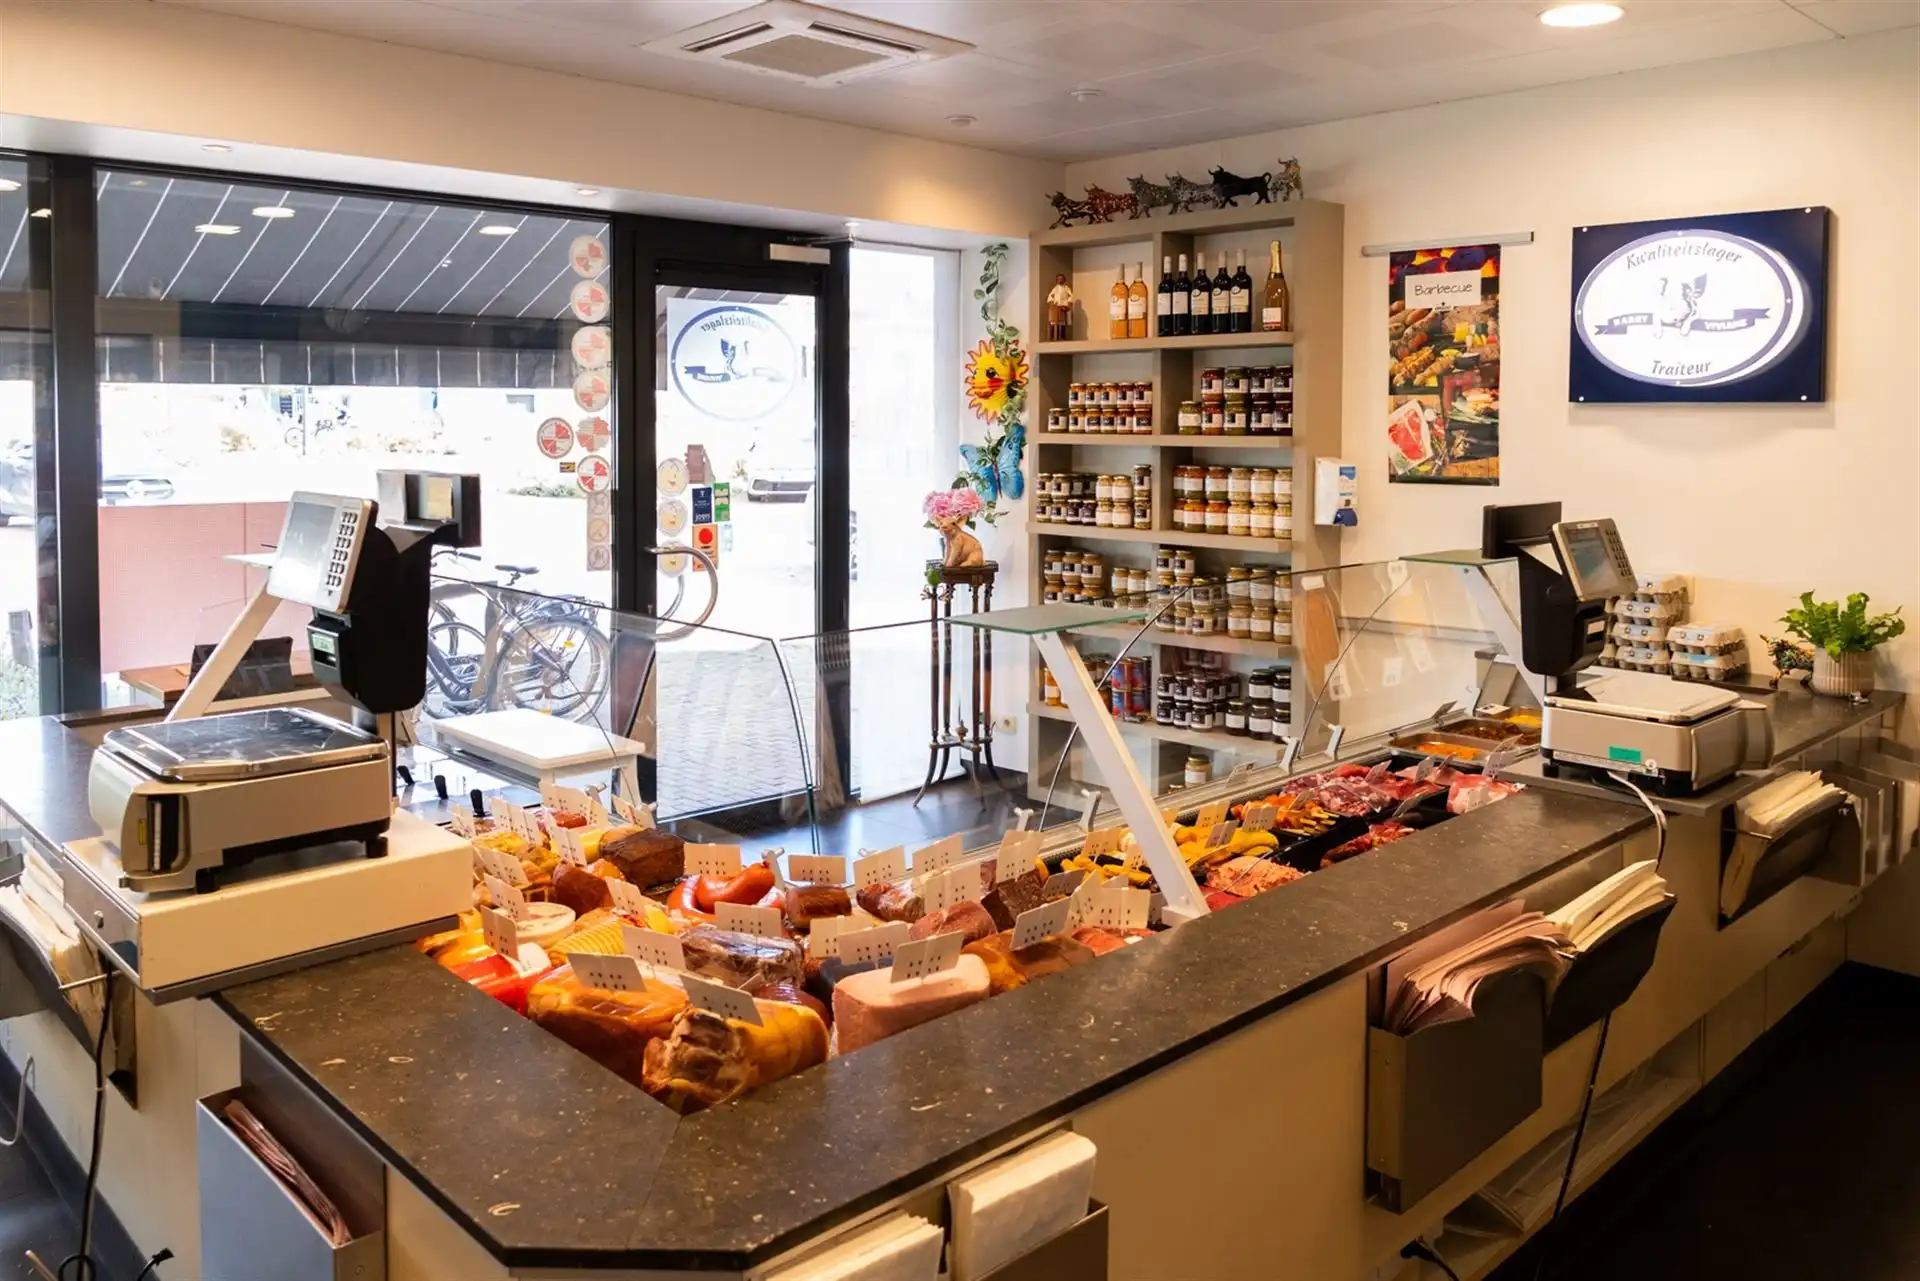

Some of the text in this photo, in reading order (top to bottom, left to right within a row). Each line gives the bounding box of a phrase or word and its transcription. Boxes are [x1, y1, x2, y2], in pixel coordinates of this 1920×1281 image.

[1626, 240, 1743, 269] Kwaliteitslager
[1414, 281, 1473, 297] Barbecue
[1650, 359, 1712, 377] Traiteur
